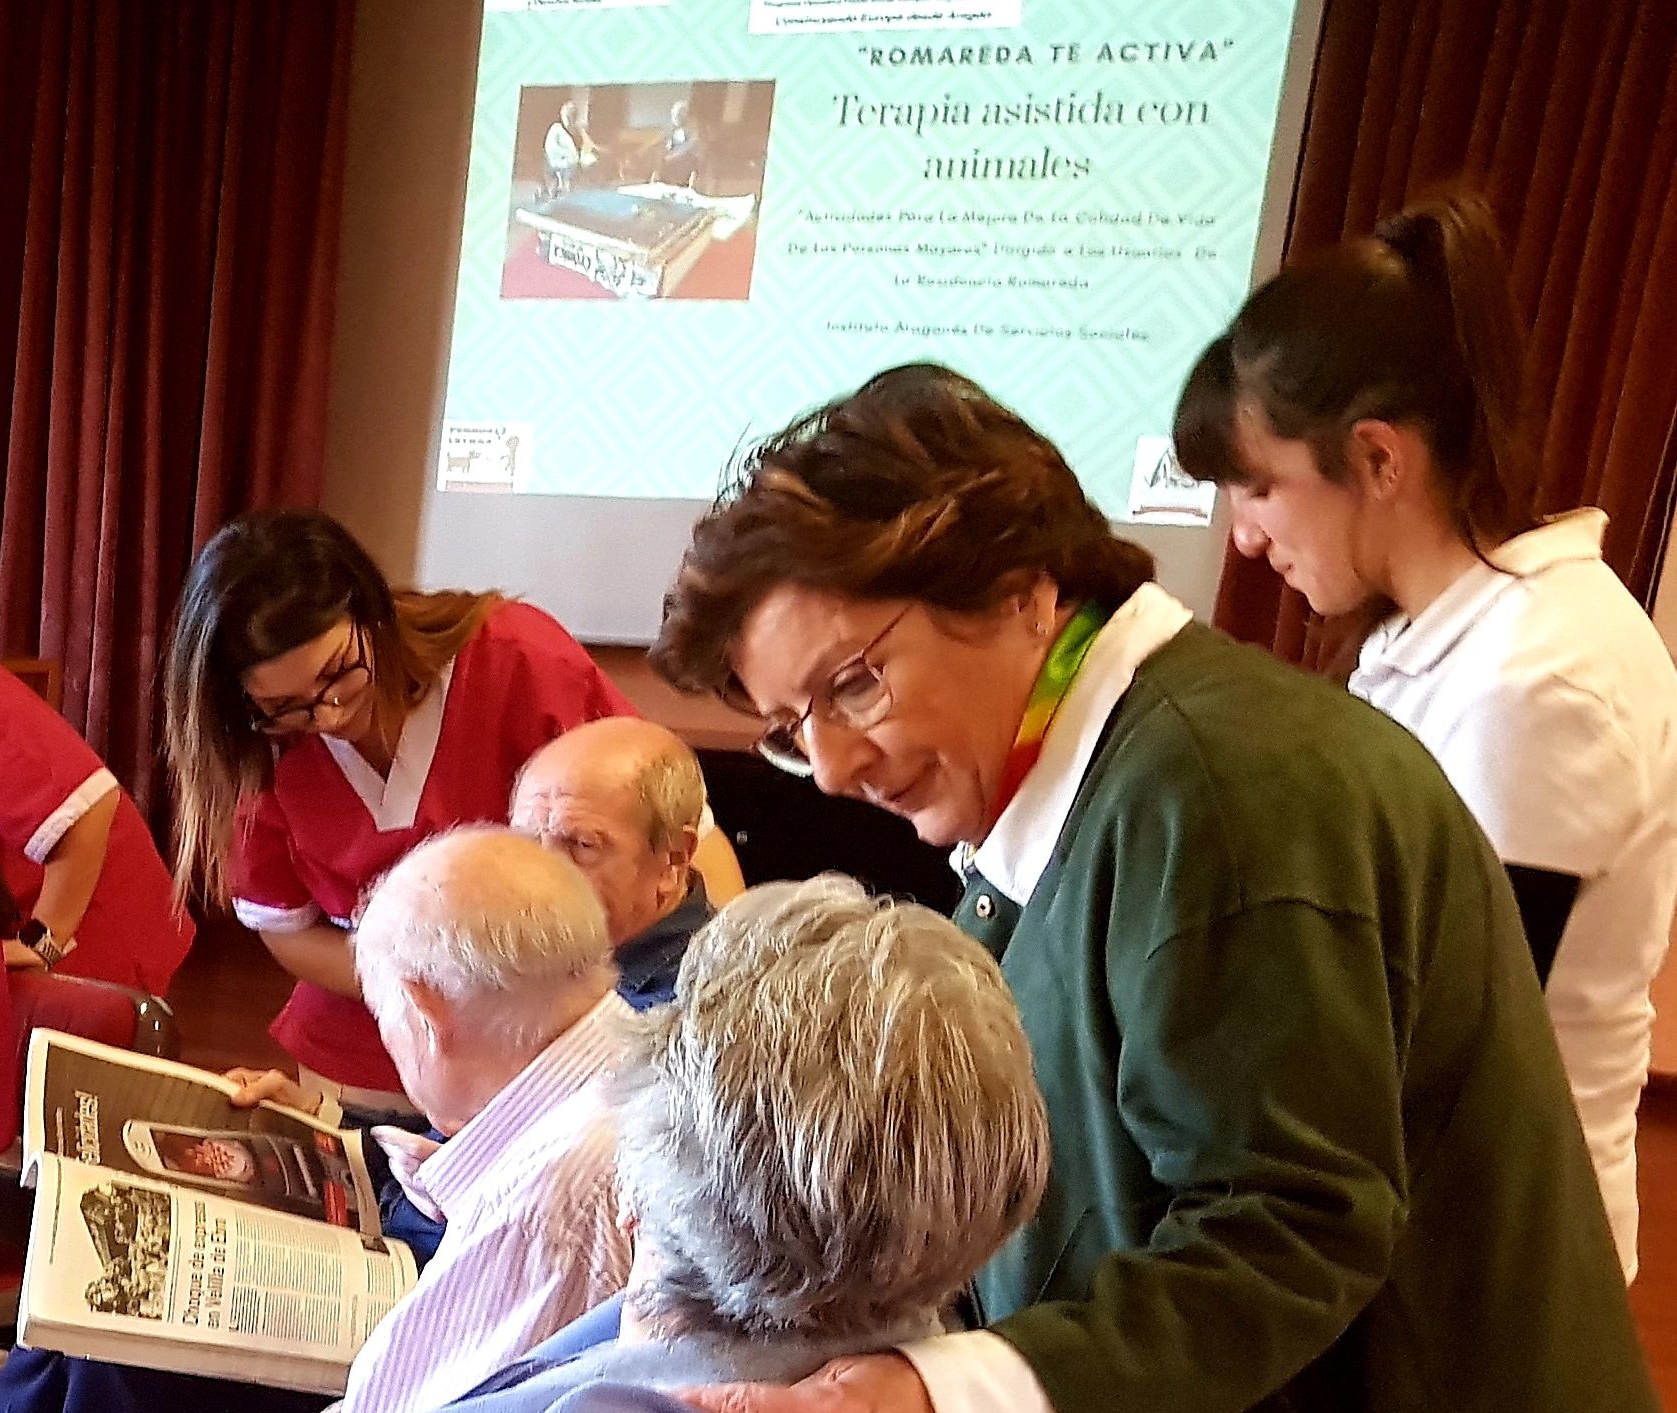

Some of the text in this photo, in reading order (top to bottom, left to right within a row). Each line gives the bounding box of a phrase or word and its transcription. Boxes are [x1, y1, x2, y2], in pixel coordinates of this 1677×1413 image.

[1049, 42, 1082, 65] TE
[832, 88, 1212, 137] Terapia asistida con
[923, 147, 1092, 180] animales
[188, 1252, 204, 1270] de
[210, 1247, 226, 1263] de
[182, 1273, 204, 1326] Choque
[207, 1311, 221, 1329] en
